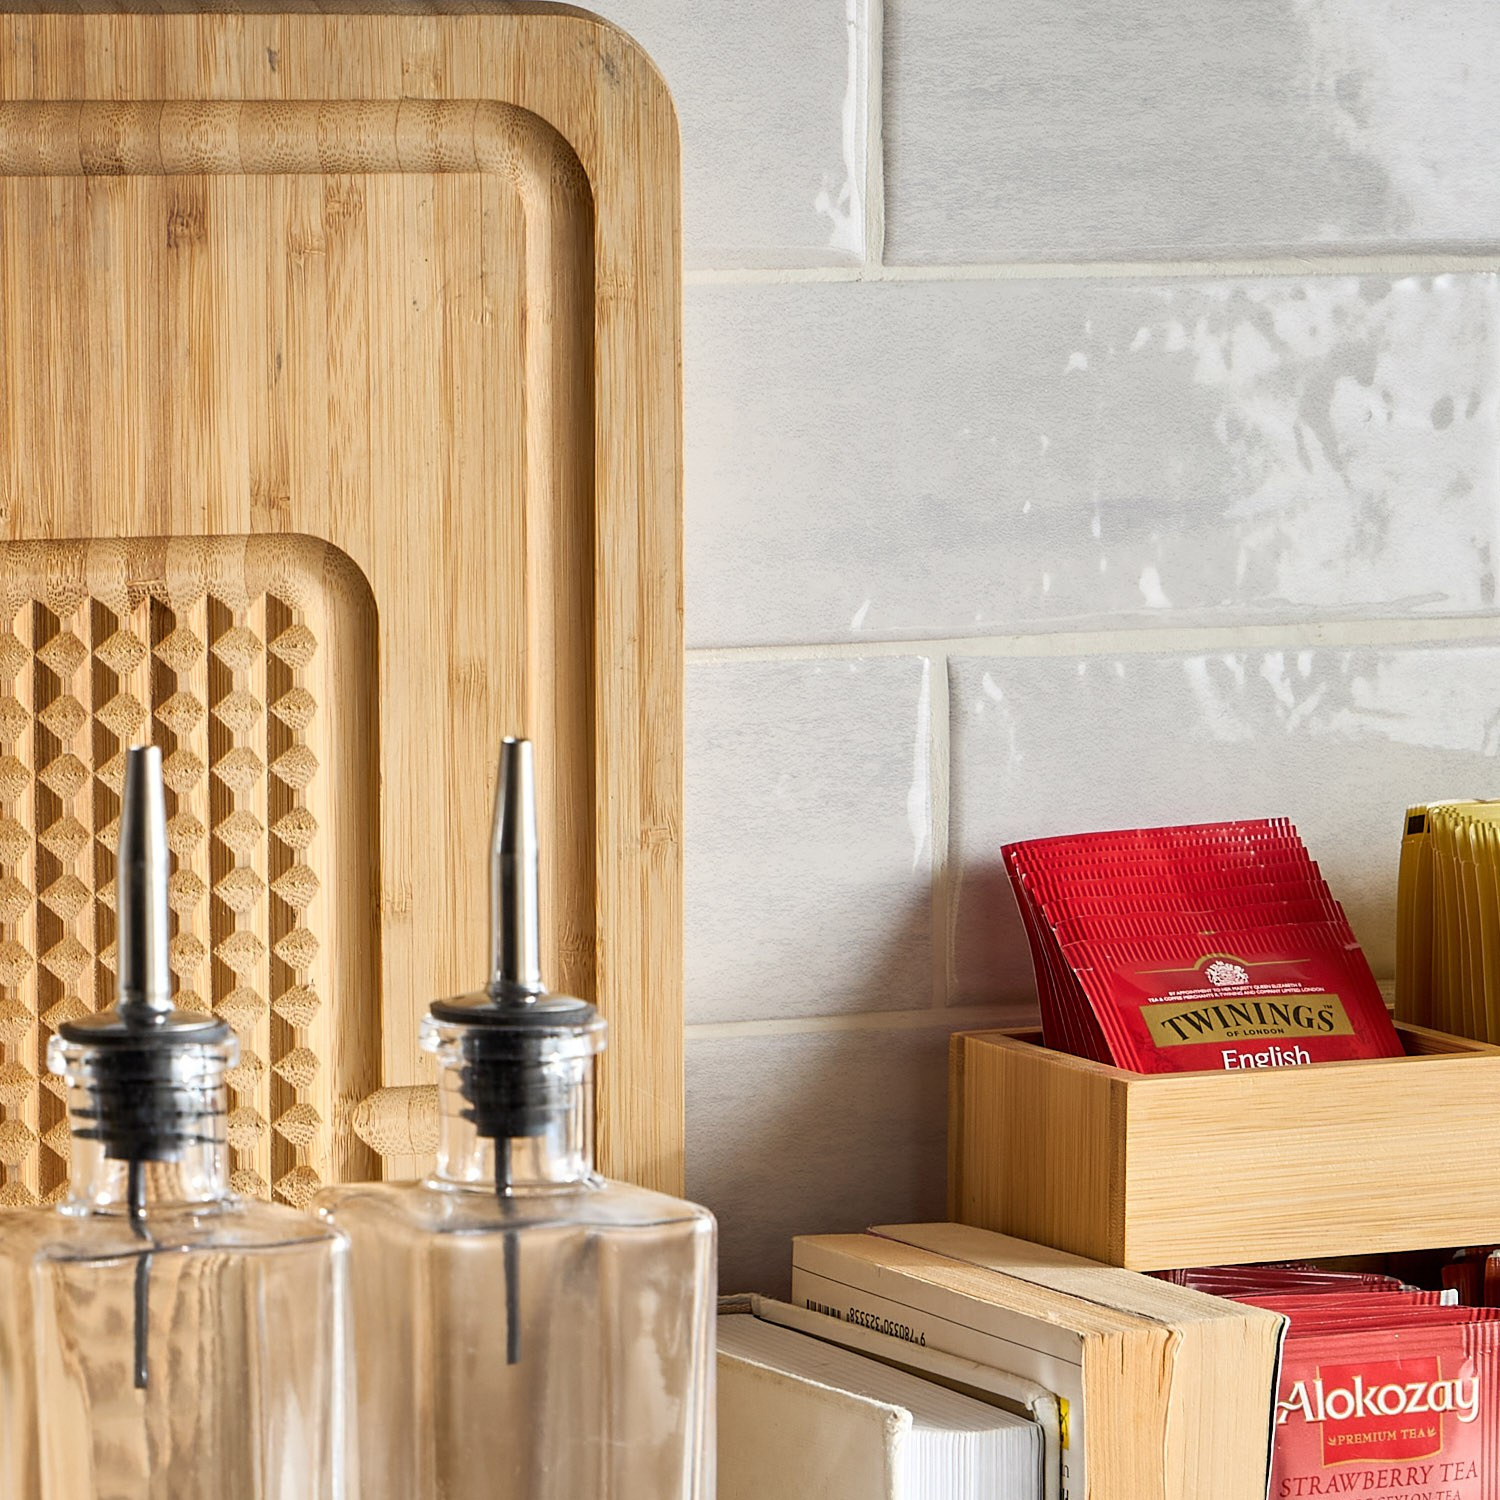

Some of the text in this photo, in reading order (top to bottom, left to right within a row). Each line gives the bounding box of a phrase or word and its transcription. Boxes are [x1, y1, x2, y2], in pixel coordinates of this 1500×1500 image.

[1243, 1027, 1285, 1036] LONDON
[1221, 1045, 1311, 1071] English
[920, 1332, 926, 1347] 9
[1277, 1374, 1480, 1425] Alokozay
[1337, 1428, 1426, 1446] PREMIUM TEA
[1279, 1460, 1478, 1499] STRAWBERRY TEA
